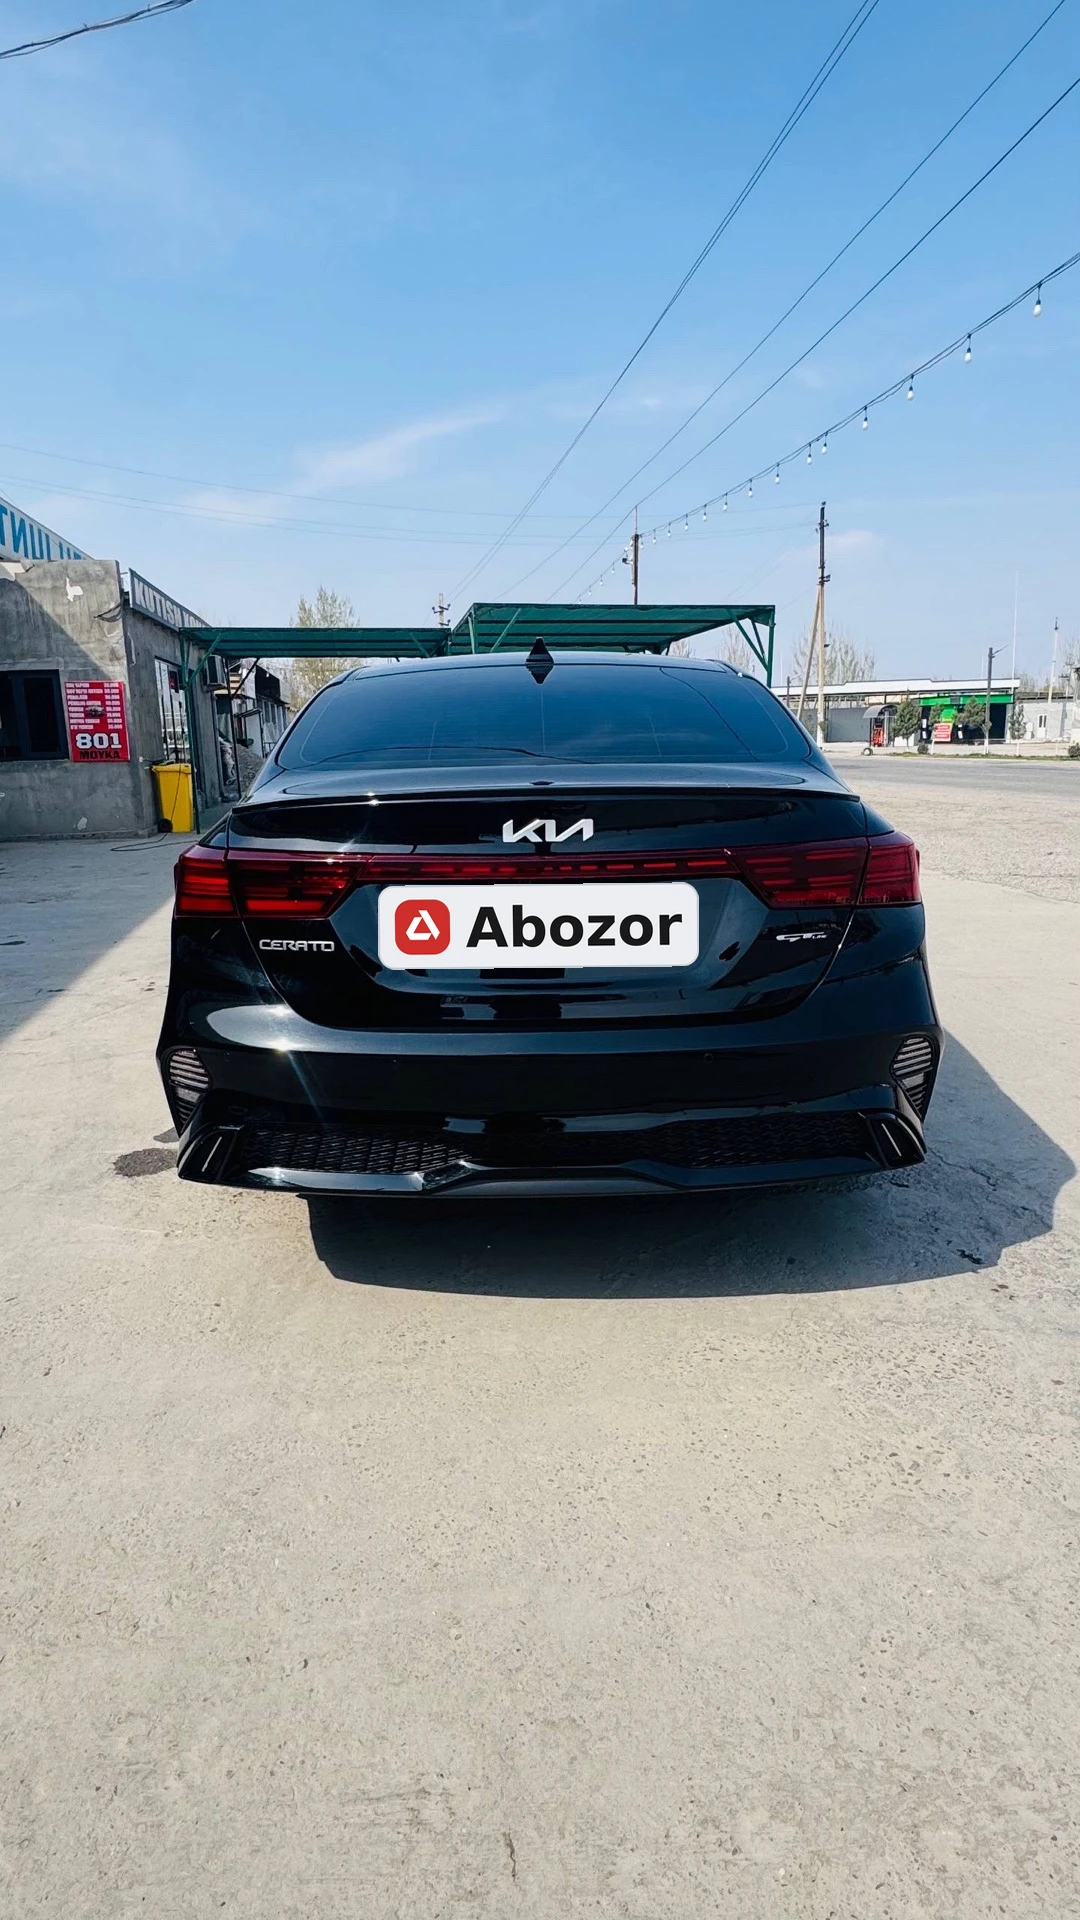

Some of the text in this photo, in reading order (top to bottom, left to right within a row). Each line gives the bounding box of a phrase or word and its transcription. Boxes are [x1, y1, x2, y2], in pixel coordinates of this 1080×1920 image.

[133, 577, 182, 628] KUTISH
[75, 732, 122, 749] 801
[80, 750, 120, 759] MOYKA
[502, 818, 594, 842] KIA
[259, 938, 335, 952] CERATO
